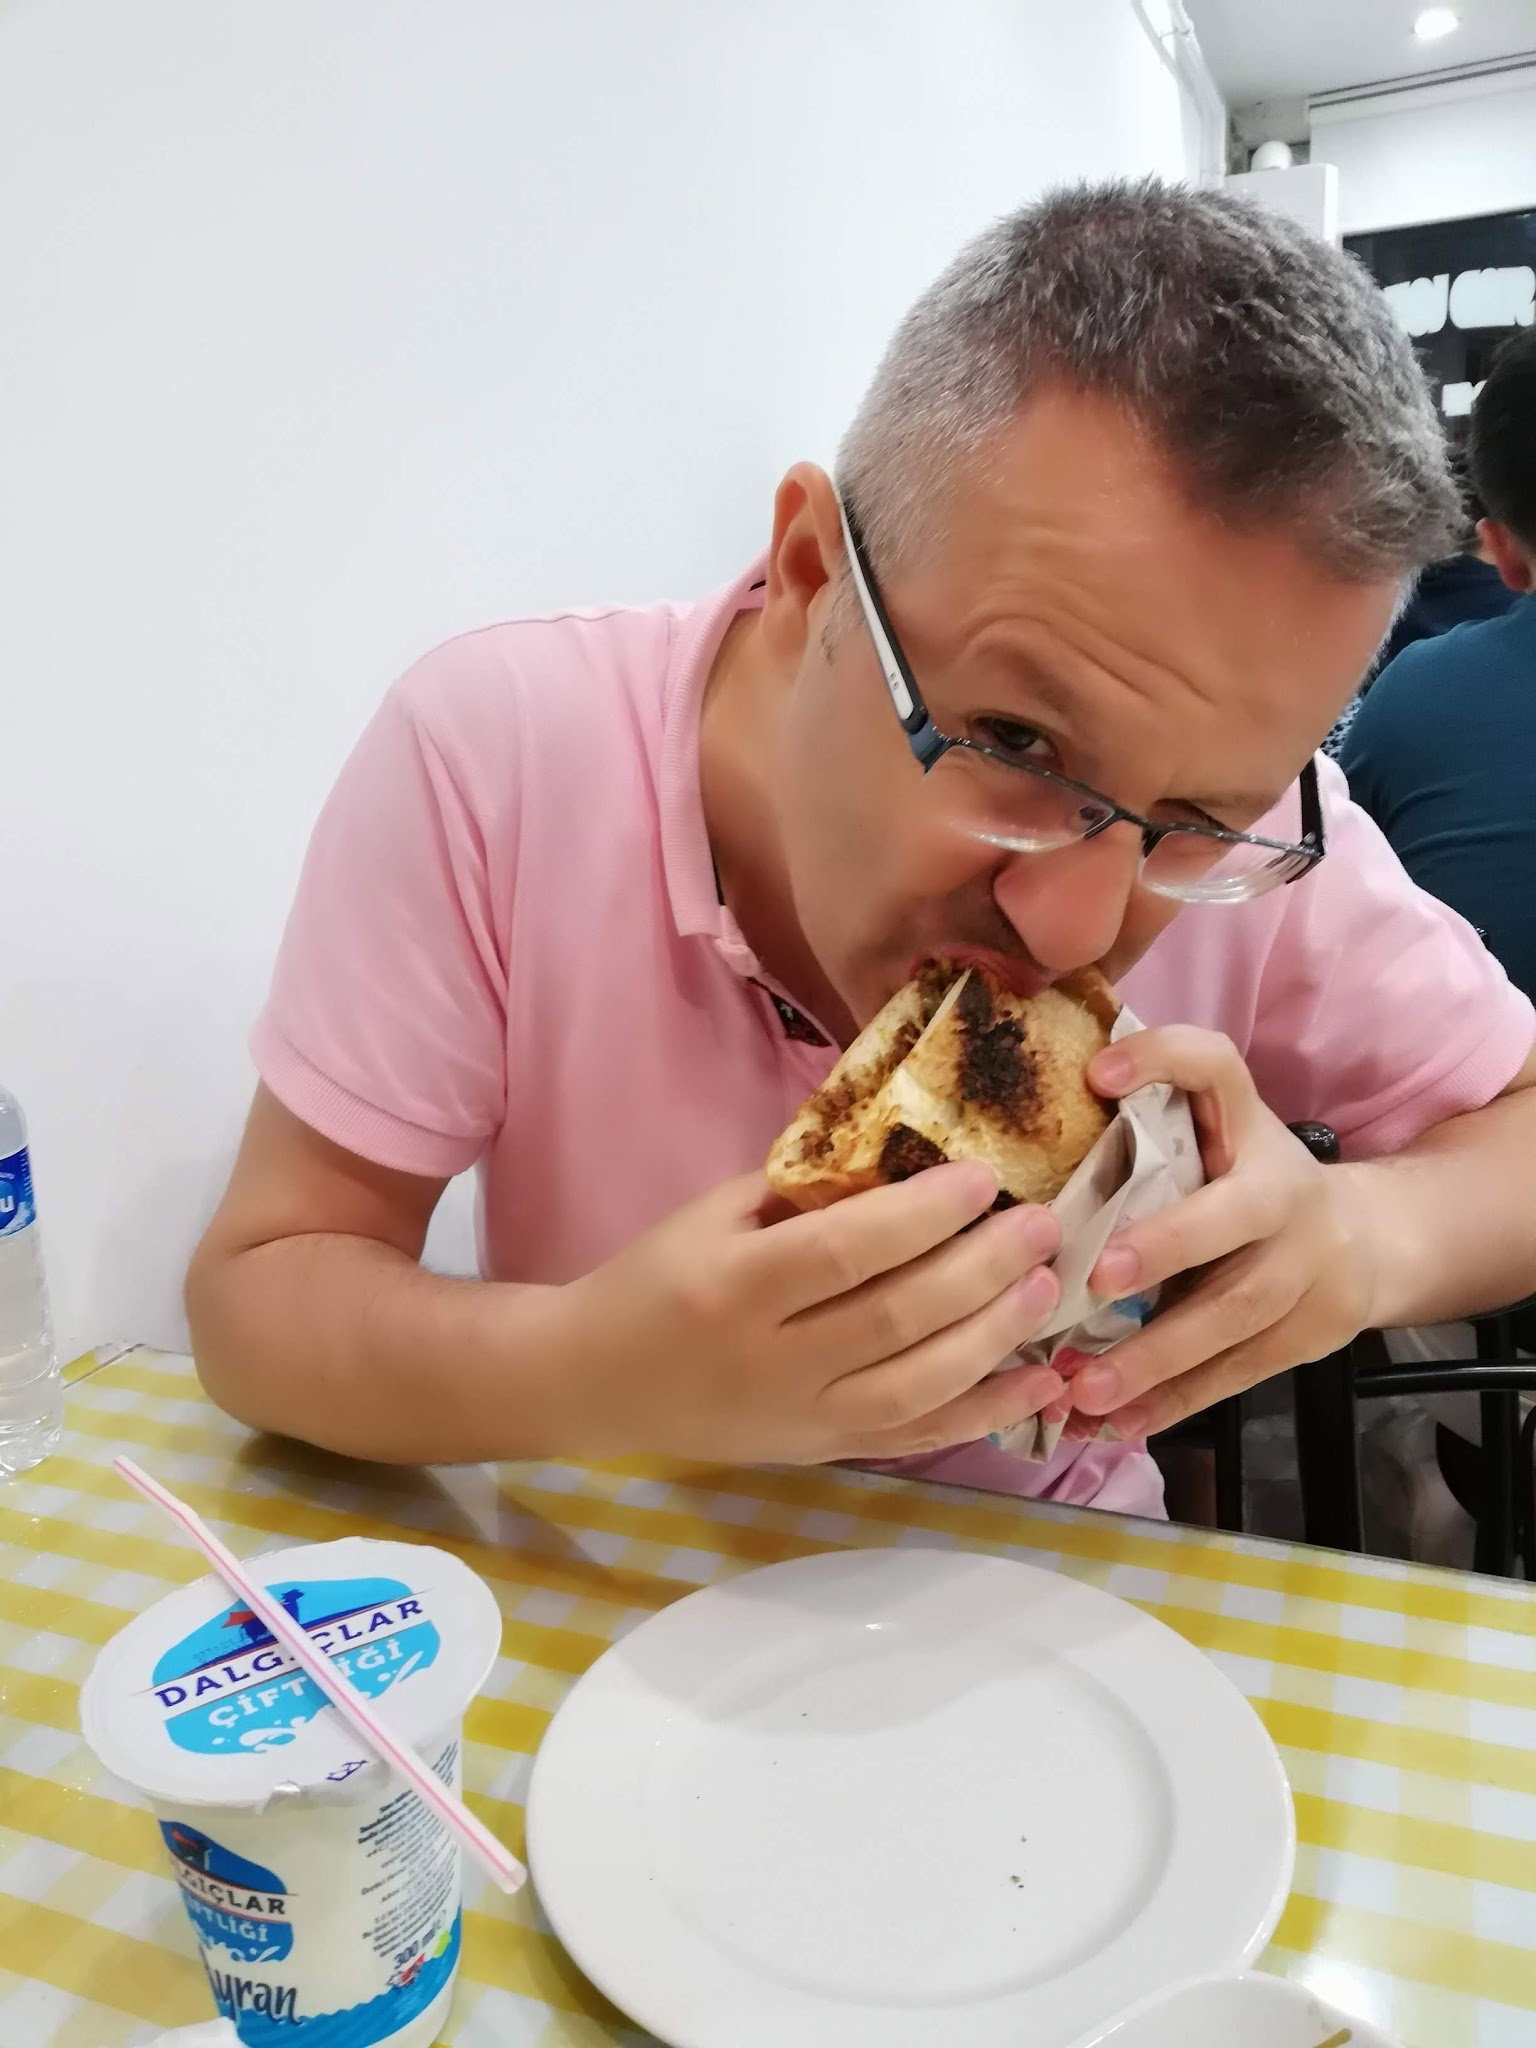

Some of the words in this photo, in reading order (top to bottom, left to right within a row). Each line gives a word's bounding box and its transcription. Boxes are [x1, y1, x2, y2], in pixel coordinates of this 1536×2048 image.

[155, 1598, 425, 1708] DALGÇLAR
[207, 1638, 404, 1729] ÇİFTİĞİ
[207, 1968, 304, 2026] yran
